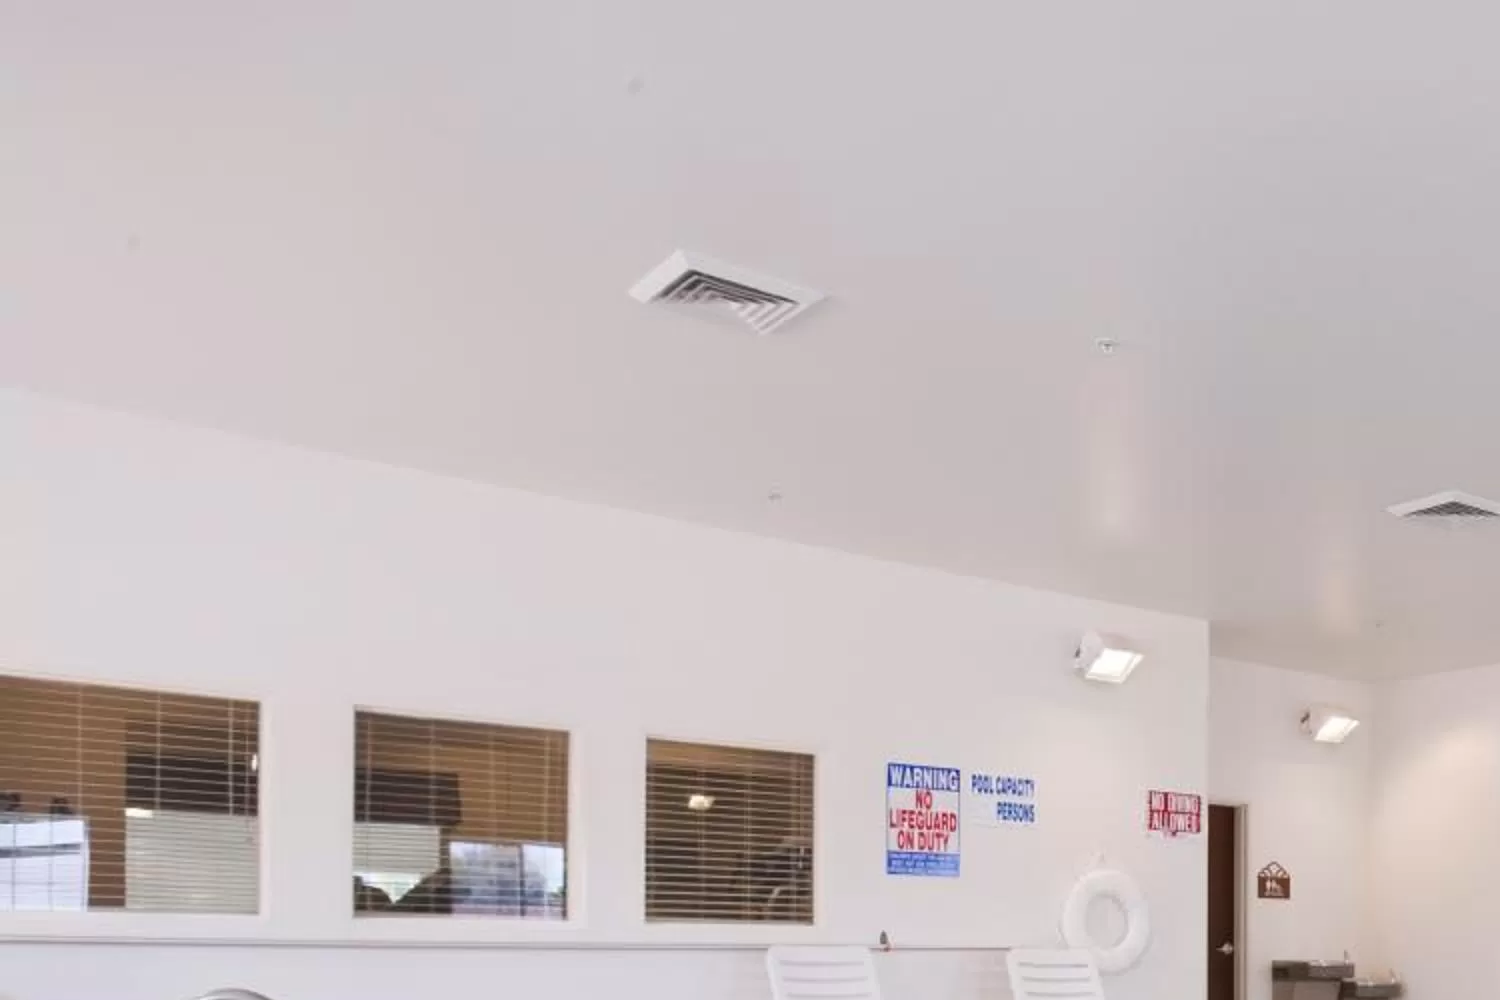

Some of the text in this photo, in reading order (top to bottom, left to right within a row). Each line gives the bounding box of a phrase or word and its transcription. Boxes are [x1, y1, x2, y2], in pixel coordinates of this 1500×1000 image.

[890, 765, 959, 790] WARNING
[971, 774, 1034, 796] POOL CAPACITY
[915, 789, 933, 809] NO
[889, 808, 956, 833] LIFEGUARD
[997, 801, 1034, 823] PERSONS
[897, 831, 949, 852] ON DUTY
